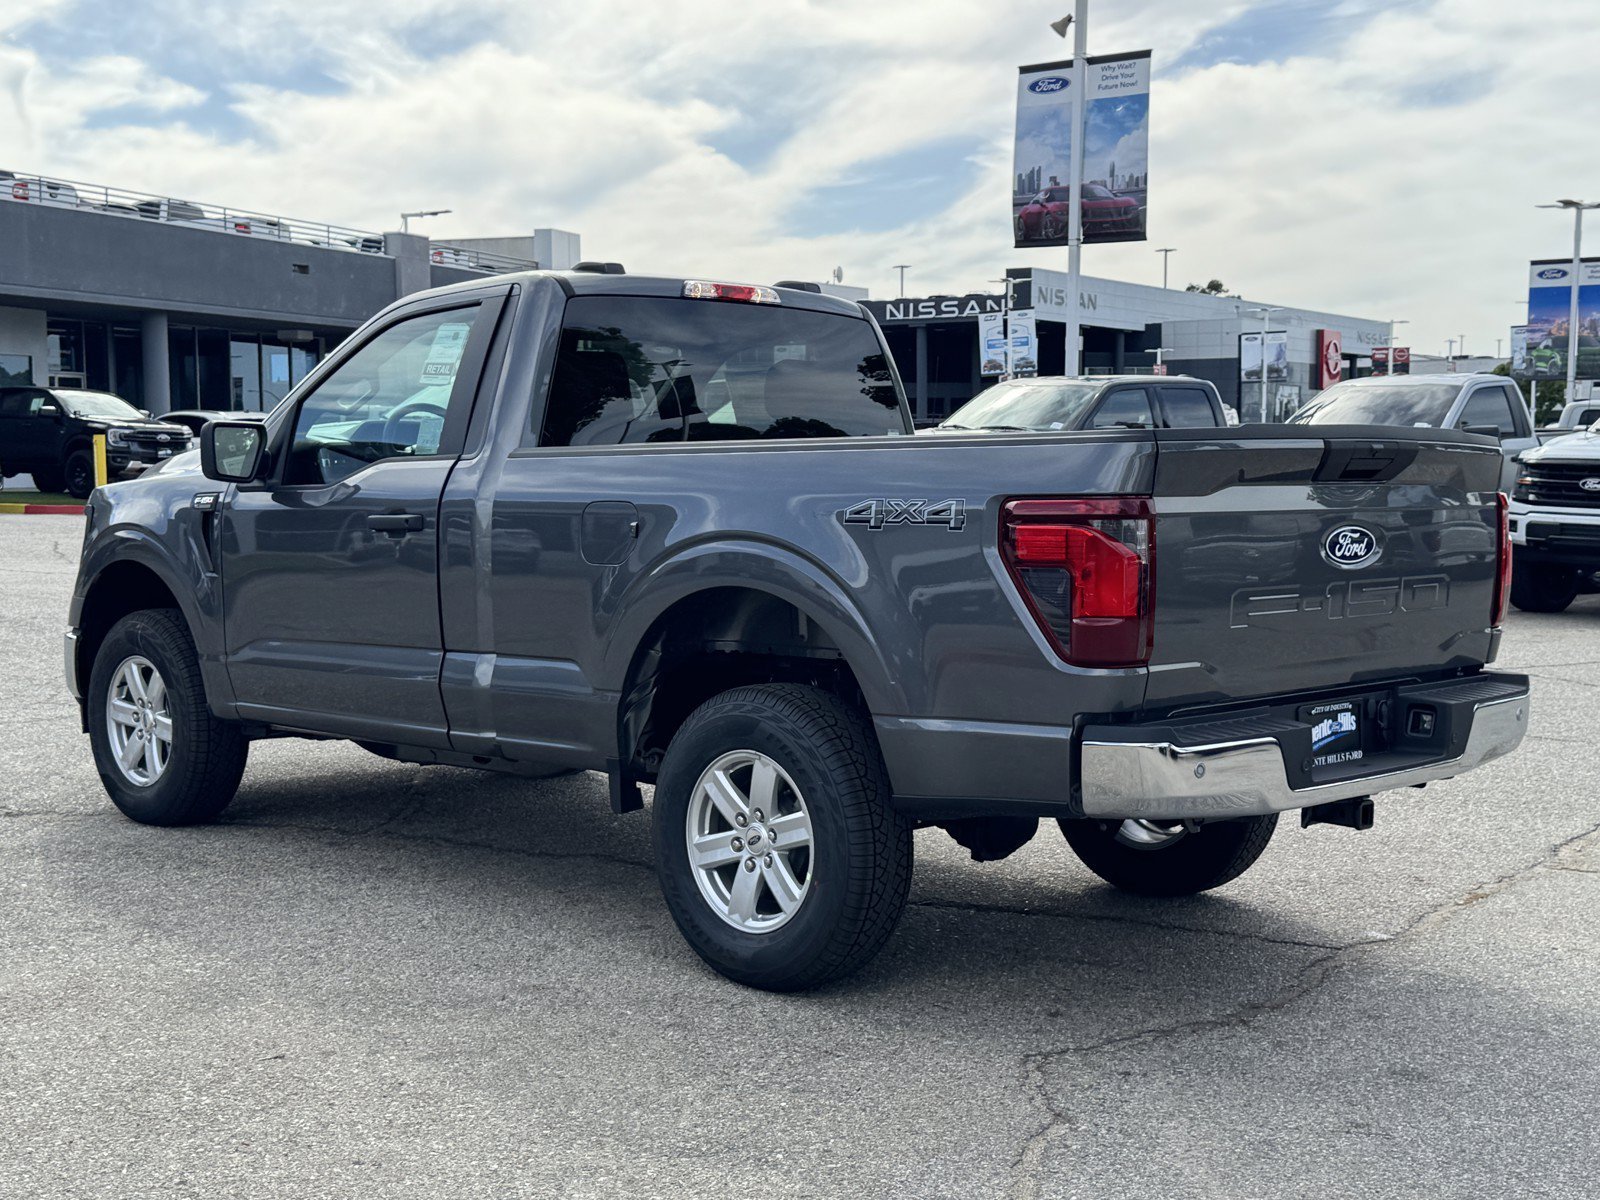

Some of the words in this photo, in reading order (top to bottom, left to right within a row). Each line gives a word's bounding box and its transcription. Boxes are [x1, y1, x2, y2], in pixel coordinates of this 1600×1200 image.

[1101, 65, 1116, 73] Why
[1117, 62, 1137, 70] Wait?
[1035, 78, 1063, 92] Ford
[1120, 80, 1138, 88] Now!
[1037, 285, 1097, 311] NISAN
[886, 298, 1005, 320] NISSAN
[426, 364, 451, 374] RETAIL
[1335, 531, 1369, 557] Ford
[1230, 573, 1450, 629] F-150
[1326, 753, 1345, 764] HILLS
